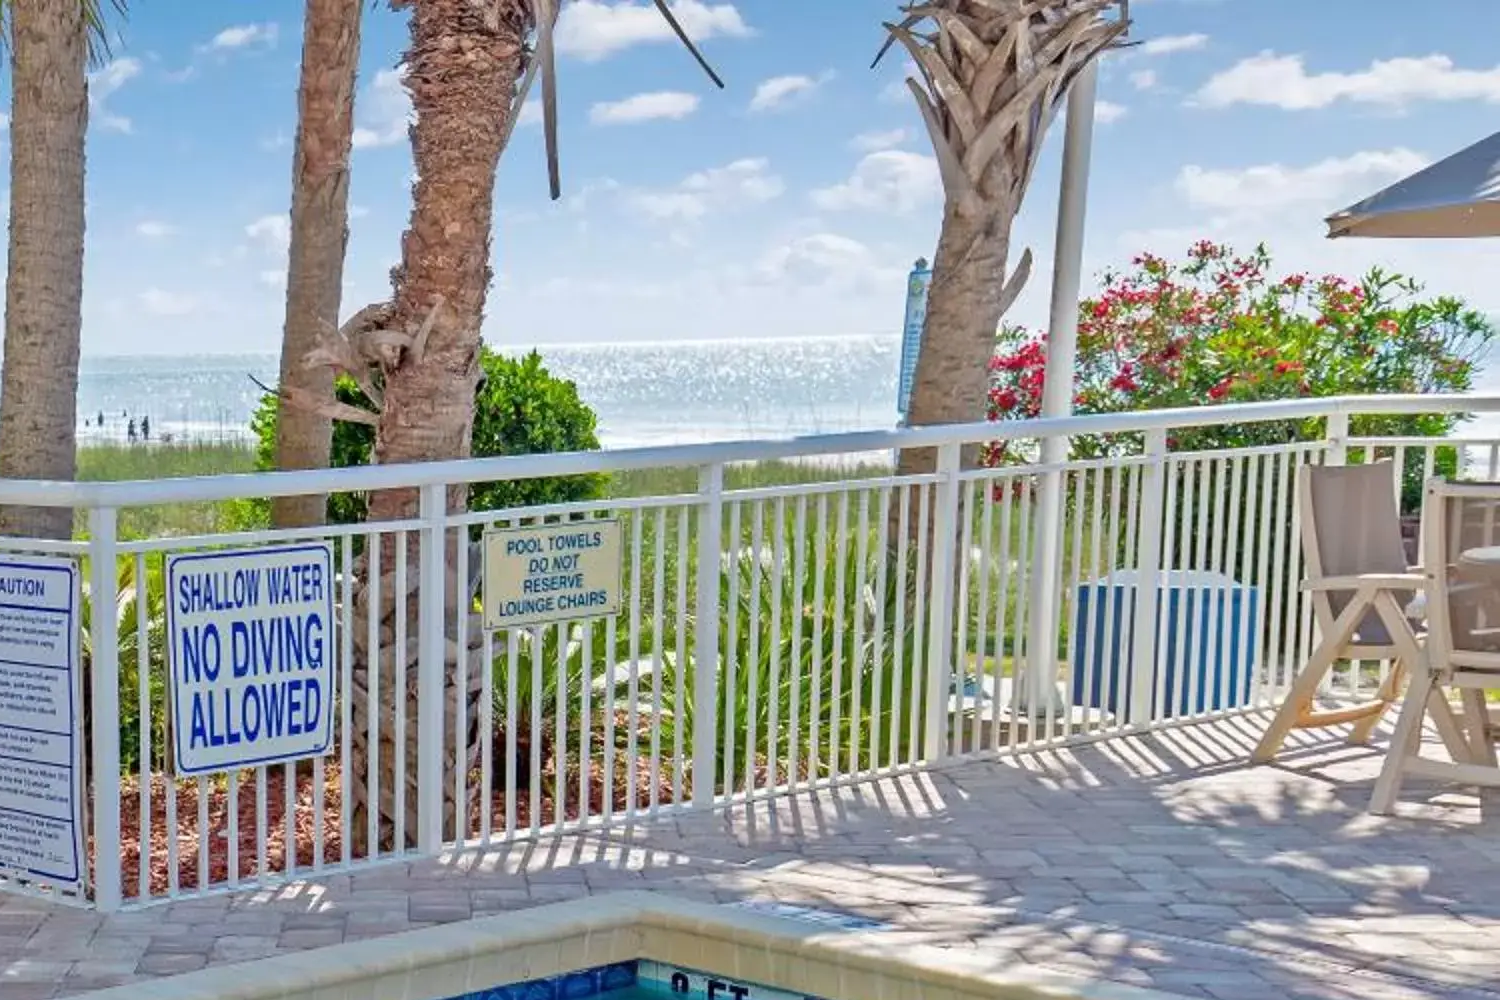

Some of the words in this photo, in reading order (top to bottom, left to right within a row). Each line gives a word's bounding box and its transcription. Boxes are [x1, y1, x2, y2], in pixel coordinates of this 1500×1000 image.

[507, 539, 544, 556] POOL
[548, 532, 602, 551] TOWELS
[529, 558, 549, 573] DO
[552, 554, 581, 570] NOT
[179, 568, 261, 614] SHALLOW
[266, 563, 323, 604] WATER
[523, 573, 584, 594] RESERVE
[499, 596, 555, 617] LOUNGE
[557, 591, 608, 611] CHAIRS
[181, 623, 222, 684] NO
[231, 612, 323, 680] DIVING
[189, 677, 322, 750] ALLOWED
